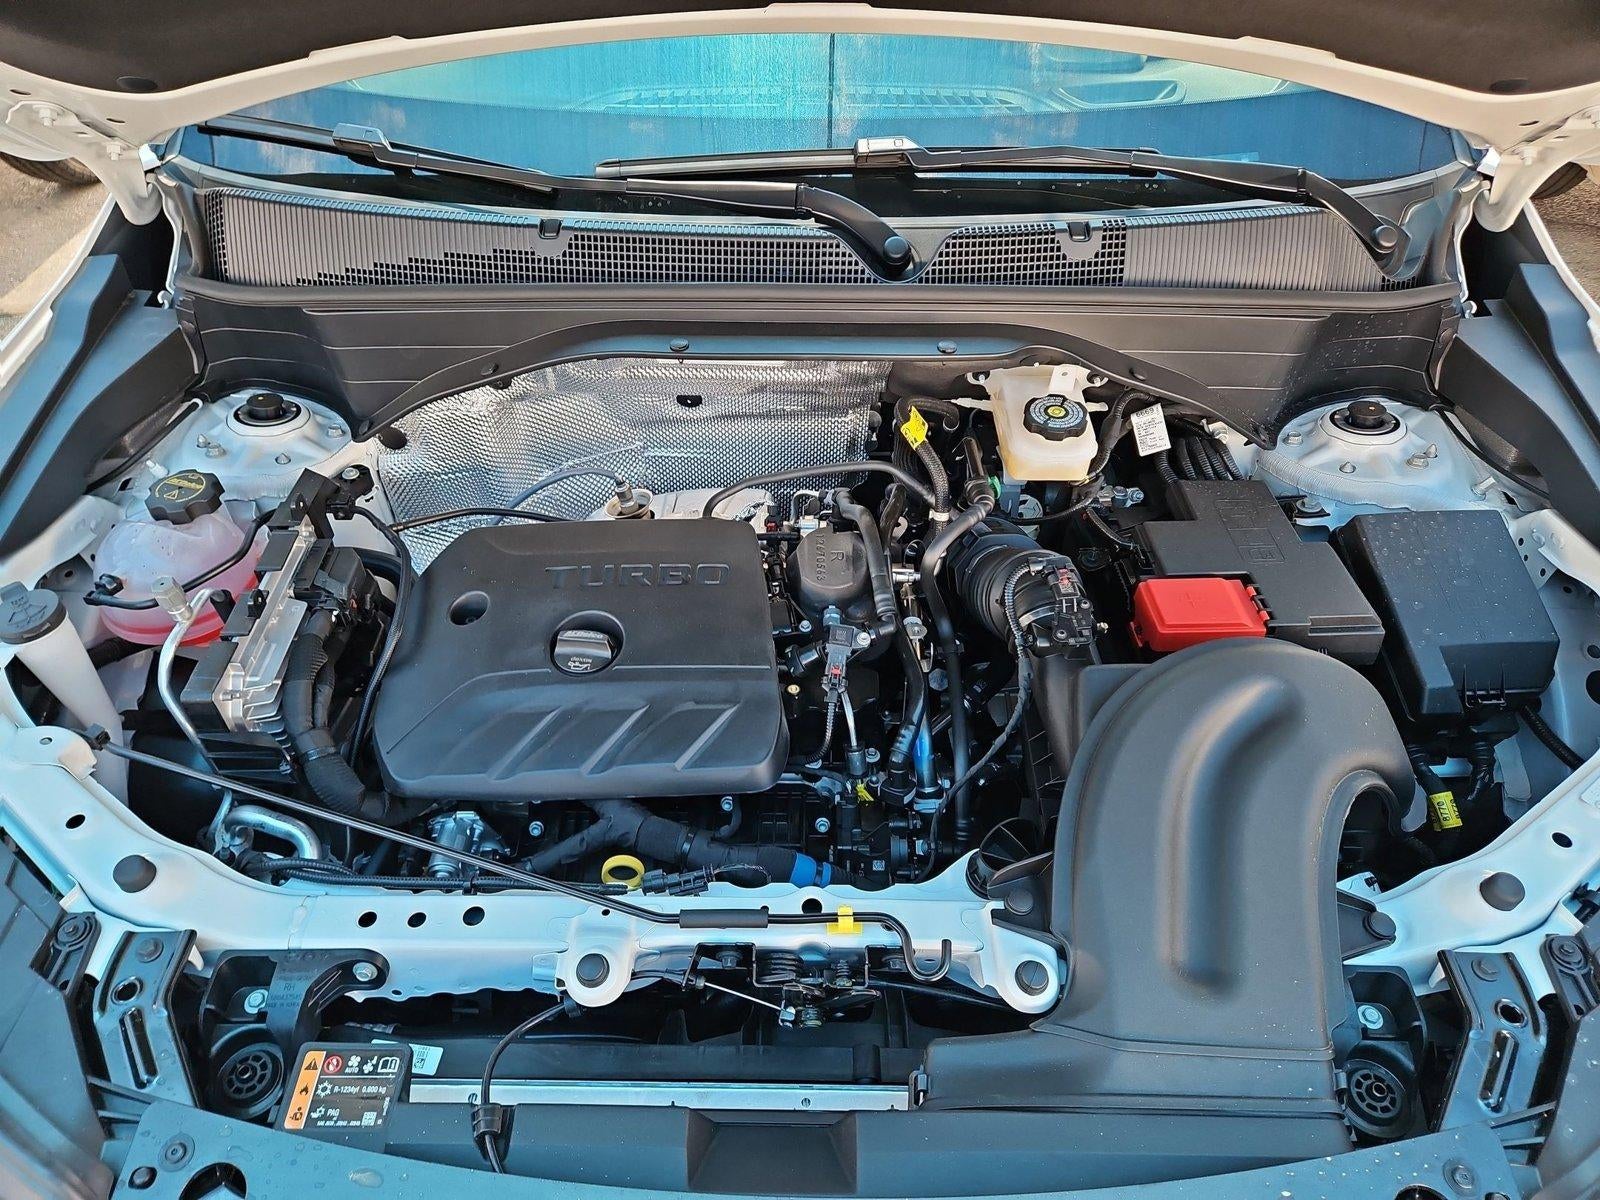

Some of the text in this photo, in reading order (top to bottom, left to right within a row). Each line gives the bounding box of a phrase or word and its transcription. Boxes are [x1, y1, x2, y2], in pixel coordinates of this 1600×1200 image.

[831, 550, 844, 562] R
[545, 563, 730, 588] TURBO
[334, 1086, 360, 1094] R-1234yf
[378, 1086, 386, 1094] kg
